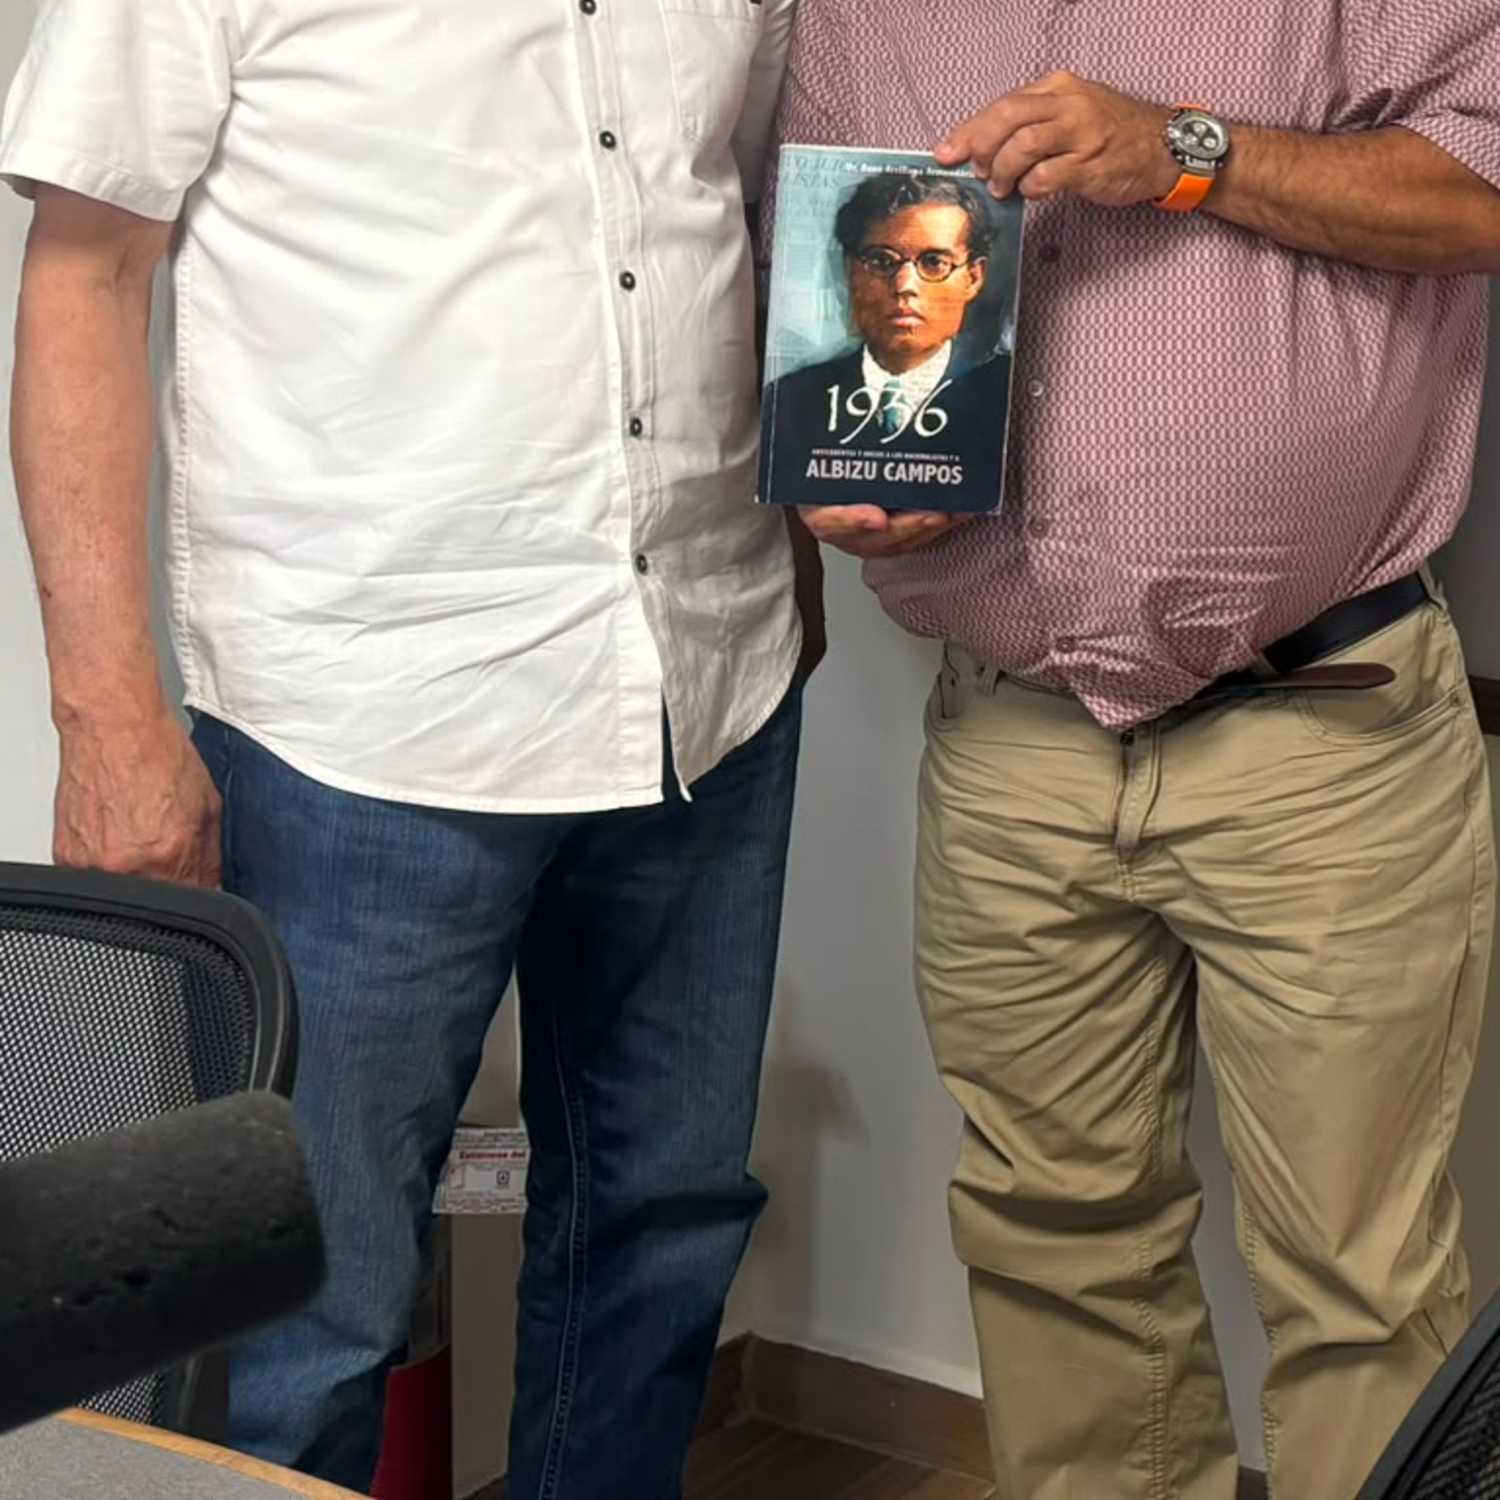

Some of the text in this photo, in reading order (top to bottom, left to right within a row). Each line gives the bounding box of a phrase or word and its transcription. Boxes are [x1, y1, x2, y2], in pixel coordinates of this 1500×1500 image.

[827, 379, 952, 444] 1936
[806, 458, 963, 485] ALBIZU CAMPOS
